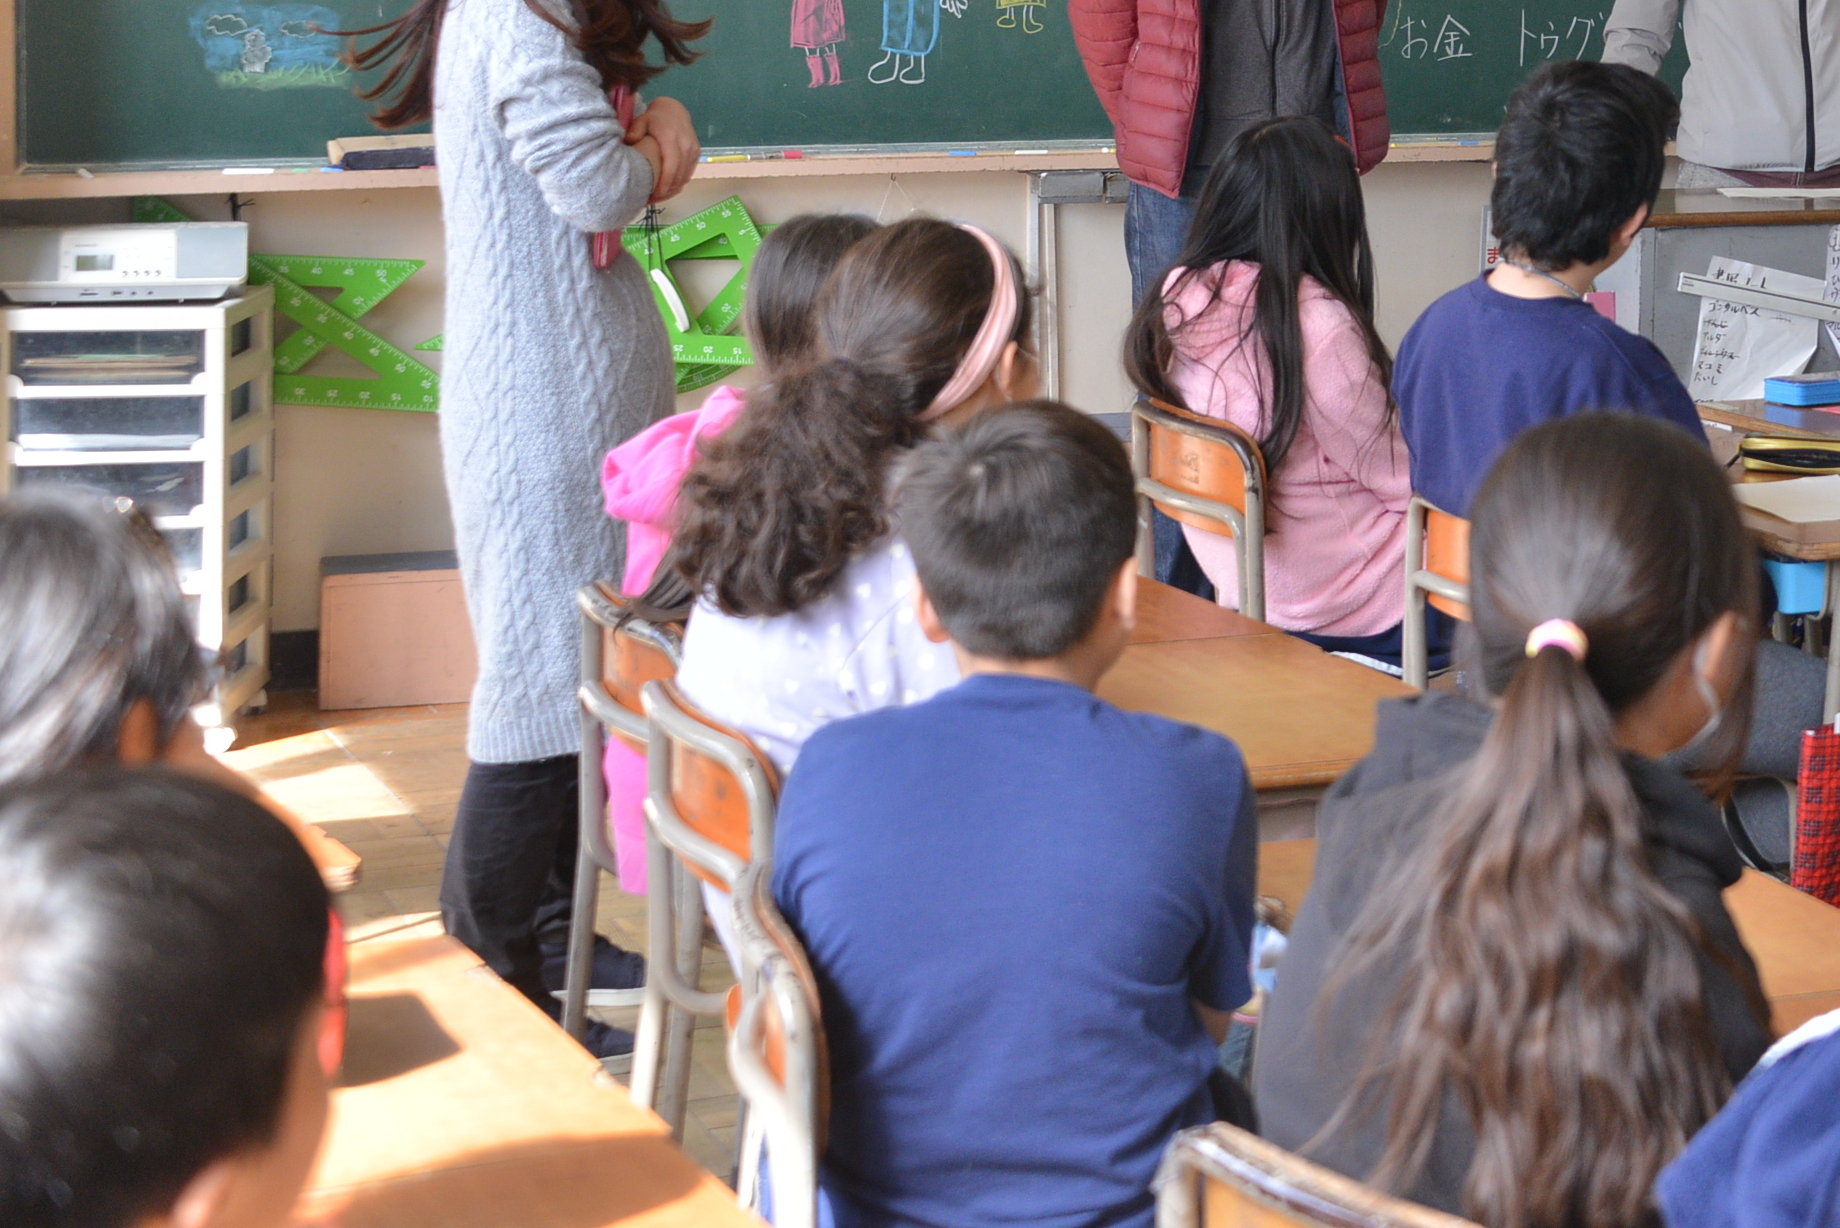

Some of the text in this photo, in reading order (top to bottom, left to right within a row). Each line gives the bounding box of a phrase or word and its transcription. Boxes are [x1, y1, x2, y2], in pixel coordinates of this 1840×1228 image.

[1400, 14, 1474, 62] お金
[703, 346, 714, 354] 20
[732, 347, 742, 355] 15
